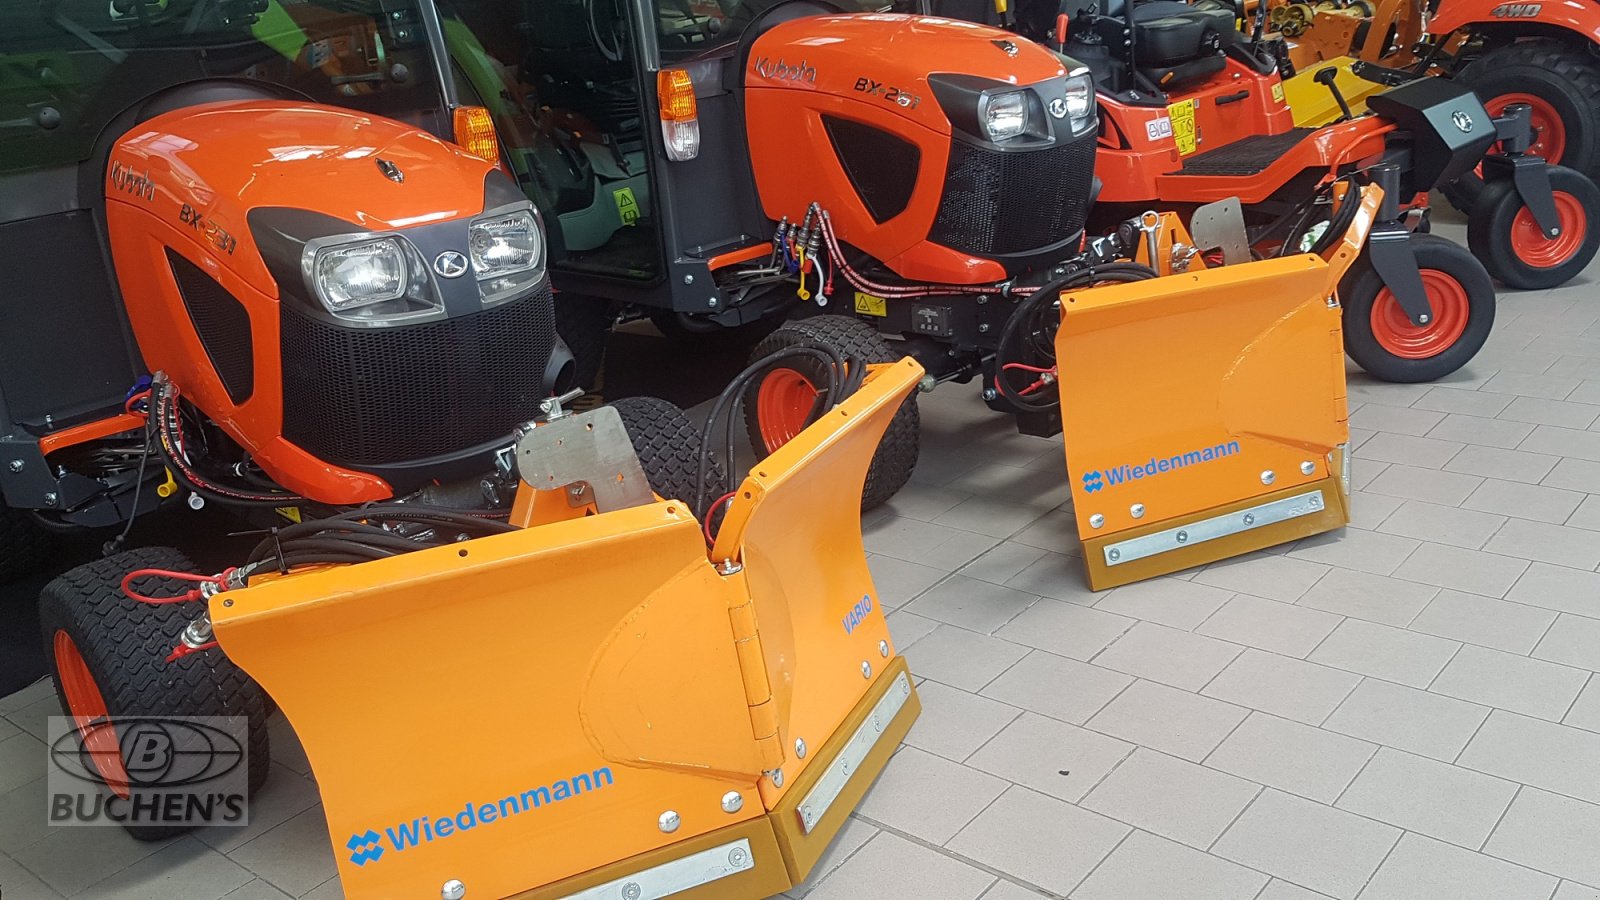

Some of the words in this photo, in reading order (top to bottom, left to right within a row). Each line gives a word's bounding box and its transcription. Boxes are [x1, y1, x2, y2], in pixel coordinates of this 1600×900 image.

[1490, 4, 1542, 18] 4WD
[754, 55, 817, 83] Kubota
[111, 159, 155, 201] Kubota
[179, 202, 237, 255] BX-231
[1104, 440, 1241, 486] Wiedenmann
[842, 594, 872, 635] VARIO
[385, 765, 614, 851] Wiedenmann
